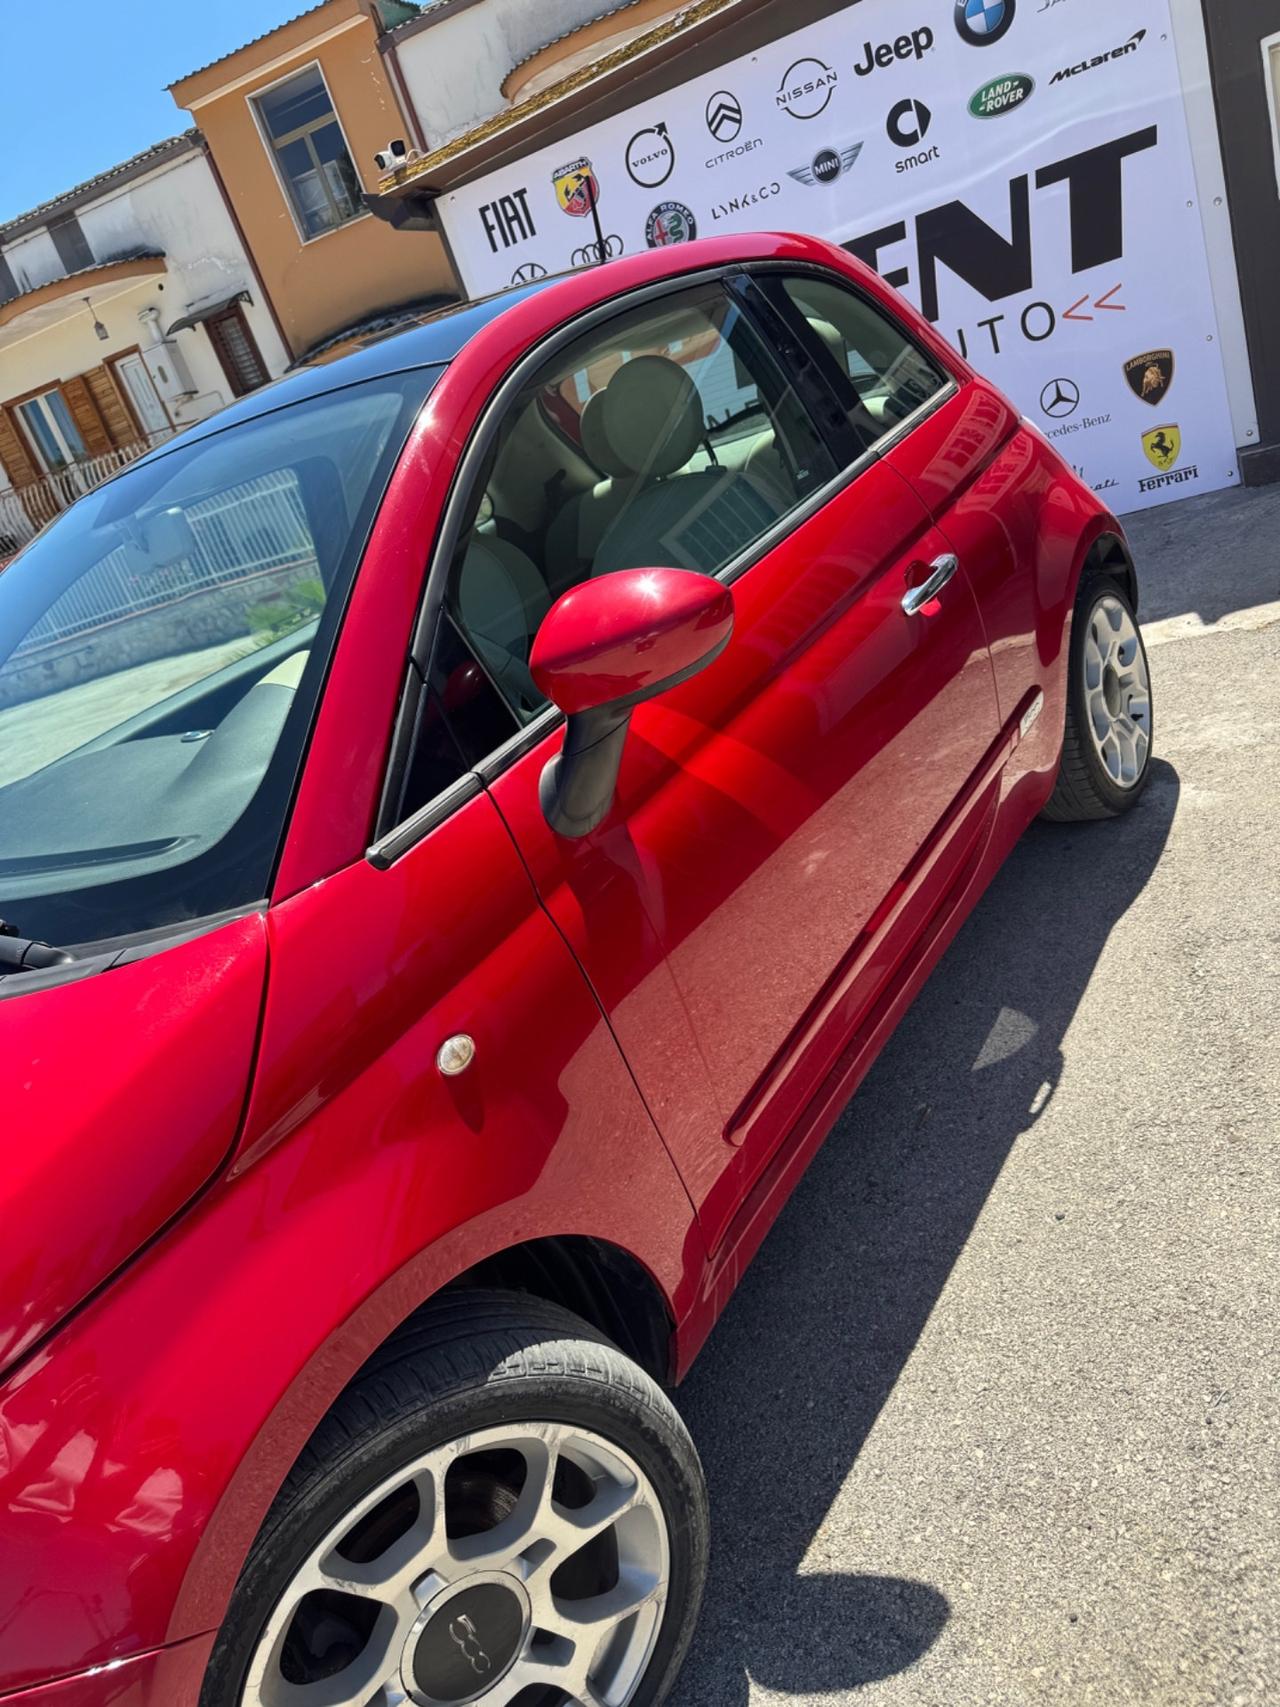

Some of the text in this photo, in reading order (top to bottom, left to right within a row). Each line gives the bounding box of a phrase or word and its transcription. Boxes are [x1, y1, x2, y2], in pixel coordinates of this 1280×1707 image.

[853, 26, 934, 77] Jeep
[1048, 40, 1138, 86] McLaren
[775, 72, 838, 106] NISSAN
[553, 160, 588, 178] ABARTH
[631, 147, 669, 168] VOLVO
[814, 158, 839, 175] MINI
[894, 144, 941, 174] smart
[478, 187, 537, 253] FIAT
[646, 202, 694, 241] ALFA ROMEO
[1137, 465, 1200, 493] Ferrari
